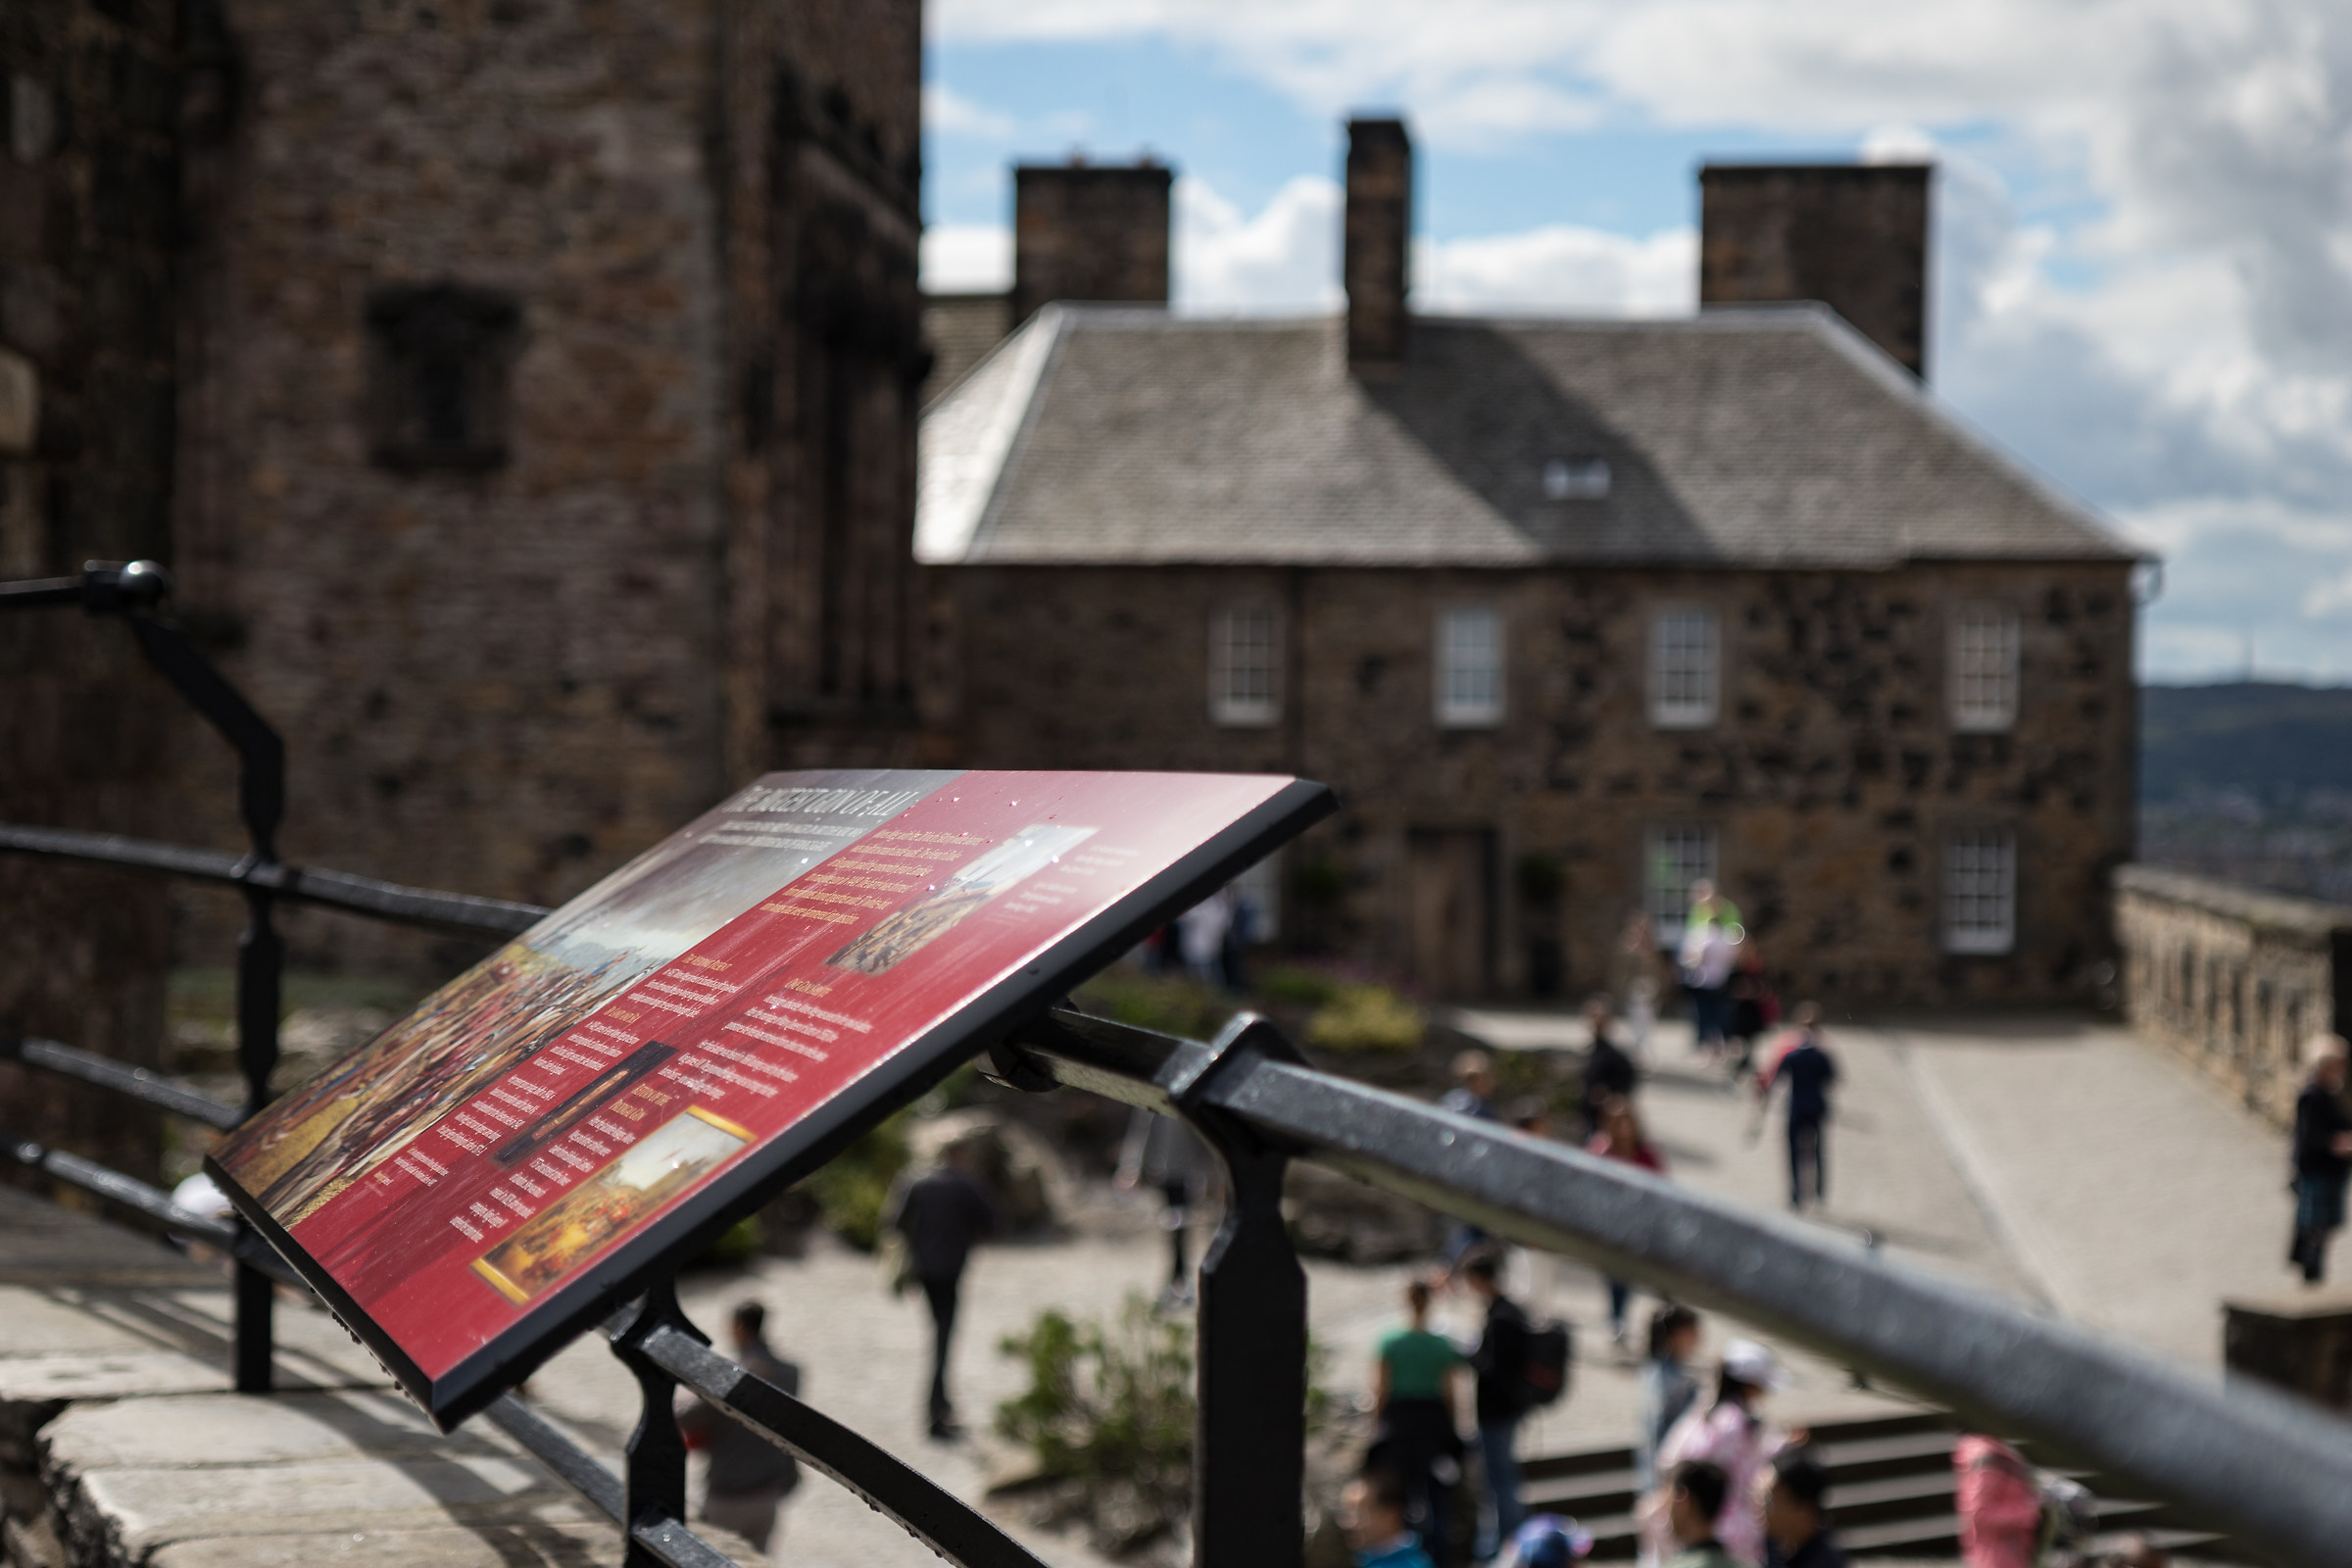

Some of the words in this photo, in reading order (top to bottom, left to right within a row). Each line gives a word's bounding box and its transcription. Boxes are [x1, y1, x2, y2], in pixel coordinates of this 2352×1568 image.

[805, 789, 862, 812] GUN
[840, 790, 888, 813] OF
[861, 791, 917, 815] ALL
